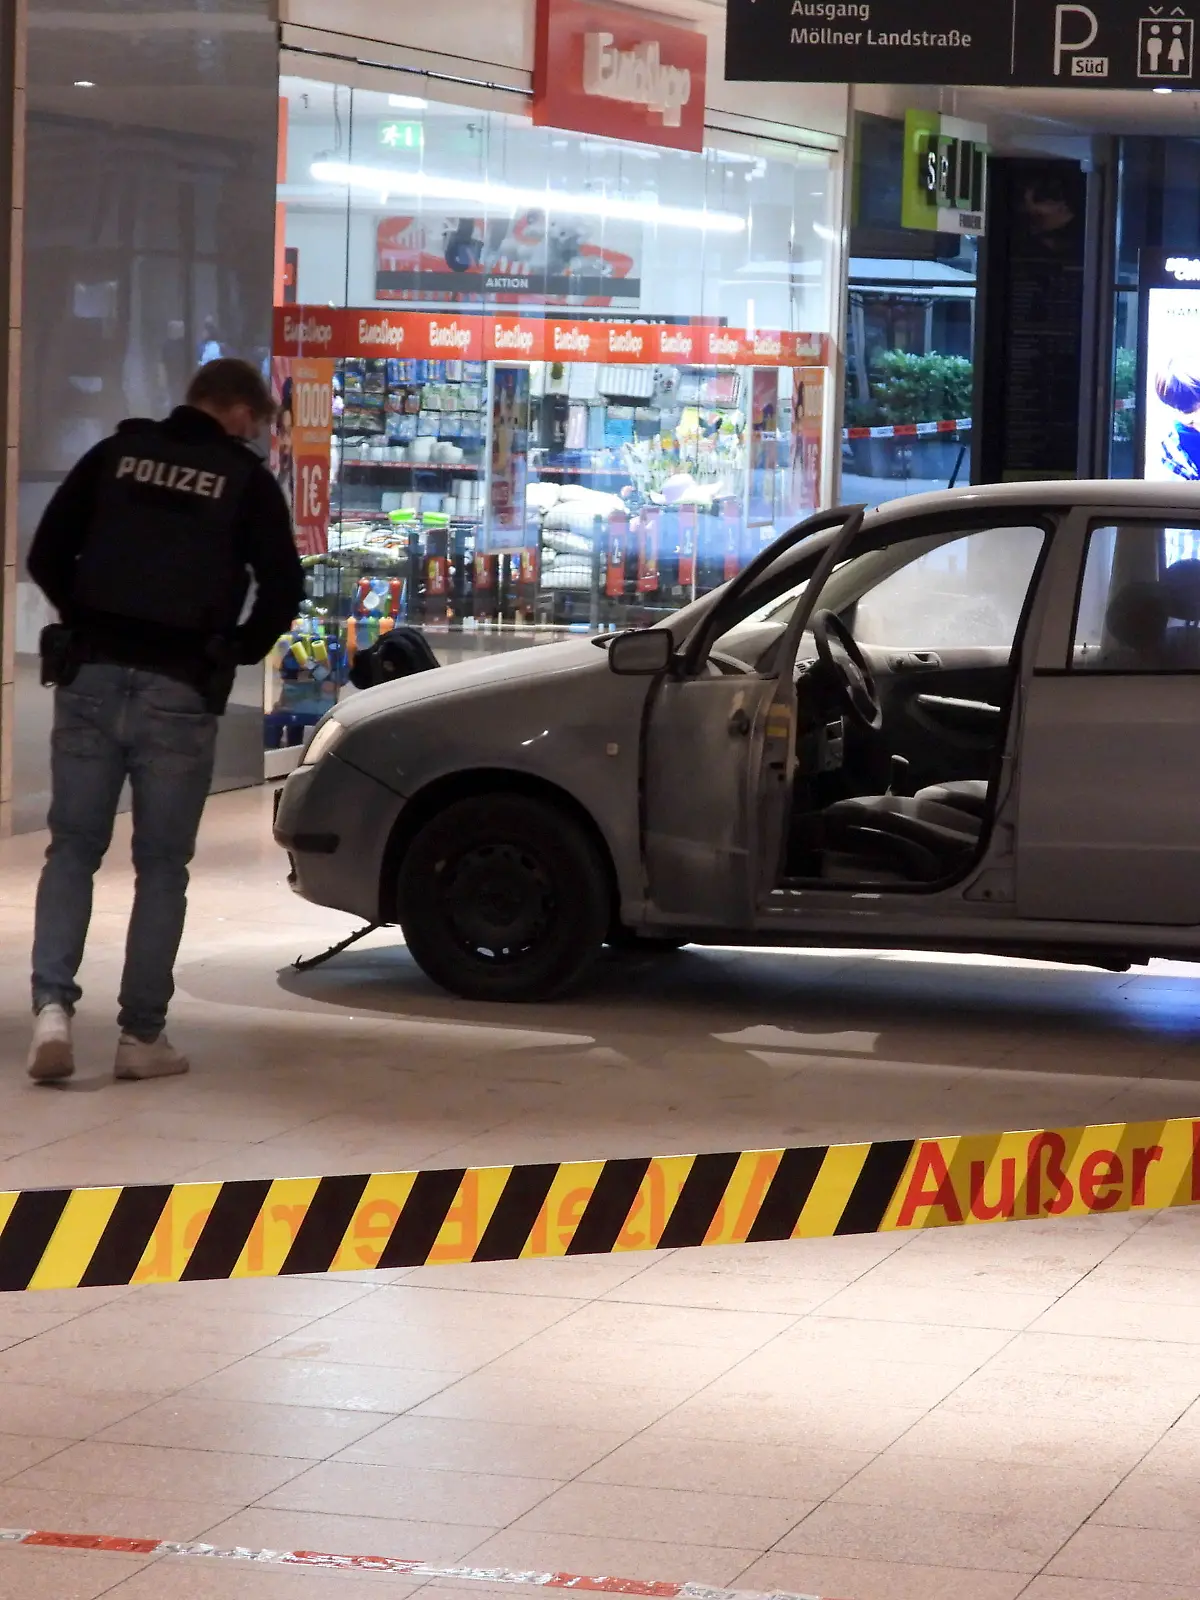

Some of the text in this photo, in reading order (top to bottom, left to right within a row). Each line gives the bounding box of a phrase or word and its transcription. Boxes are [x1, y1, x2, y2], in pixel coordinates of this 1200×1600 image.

[791, 0, 869, 20] Ausgang
[790, 27, 971, 47] Möllner Landstraße
[1054, 4, 1098, 76] P
[1075, 60, 1104, 74] Süd
[485, 276, 529, 289] AKTION
[296, 383, 331, 427] 1000
[115, 455, 227, 499] POLIZEI
[302, 464, 323, 517] 1€
[896, 1131, 1164, 1227] Außer
